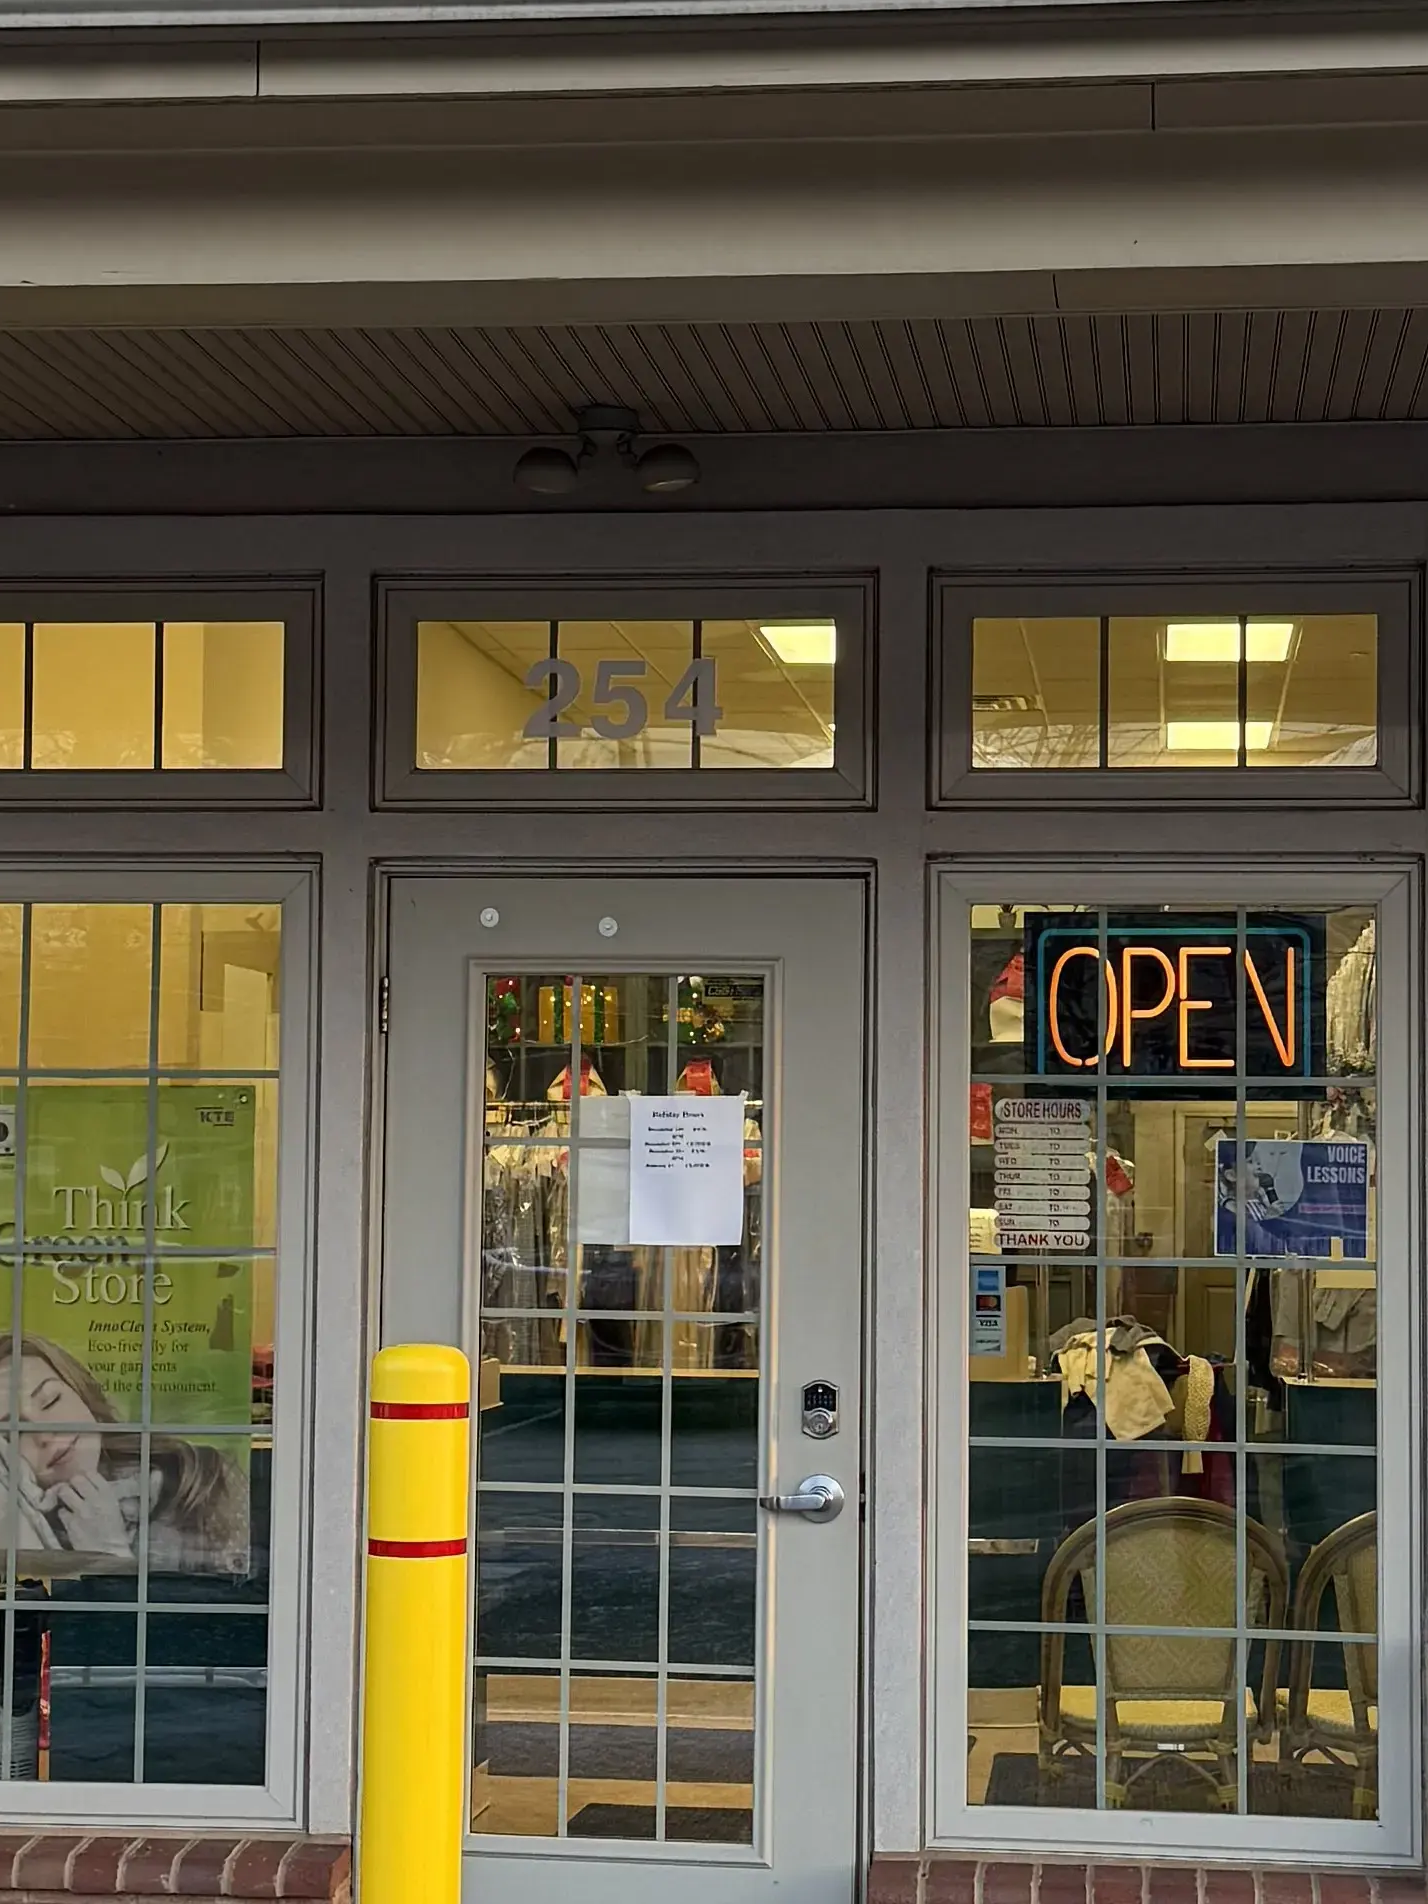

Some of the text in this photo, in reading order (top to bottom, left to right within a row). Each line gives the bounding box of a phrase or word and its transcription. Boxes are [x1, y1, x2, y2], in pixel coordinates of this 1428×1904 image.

[522, 656, 724, 740] 254
[1049, 946, 1296, 1068] OPEN
[1004, 1101, 1082, 1119] STORE HOURS
[1327, 1145, 1366, 1164] VOICE
[1307, 1166, 1365, 1184] LESSONS
[53, 1184, 192, 1232] Think
[998, 1233, 1084, 1246] THANK YOU
[52, 1260, 174, 1306] Store
[171, 1338, 190, 1353] for
